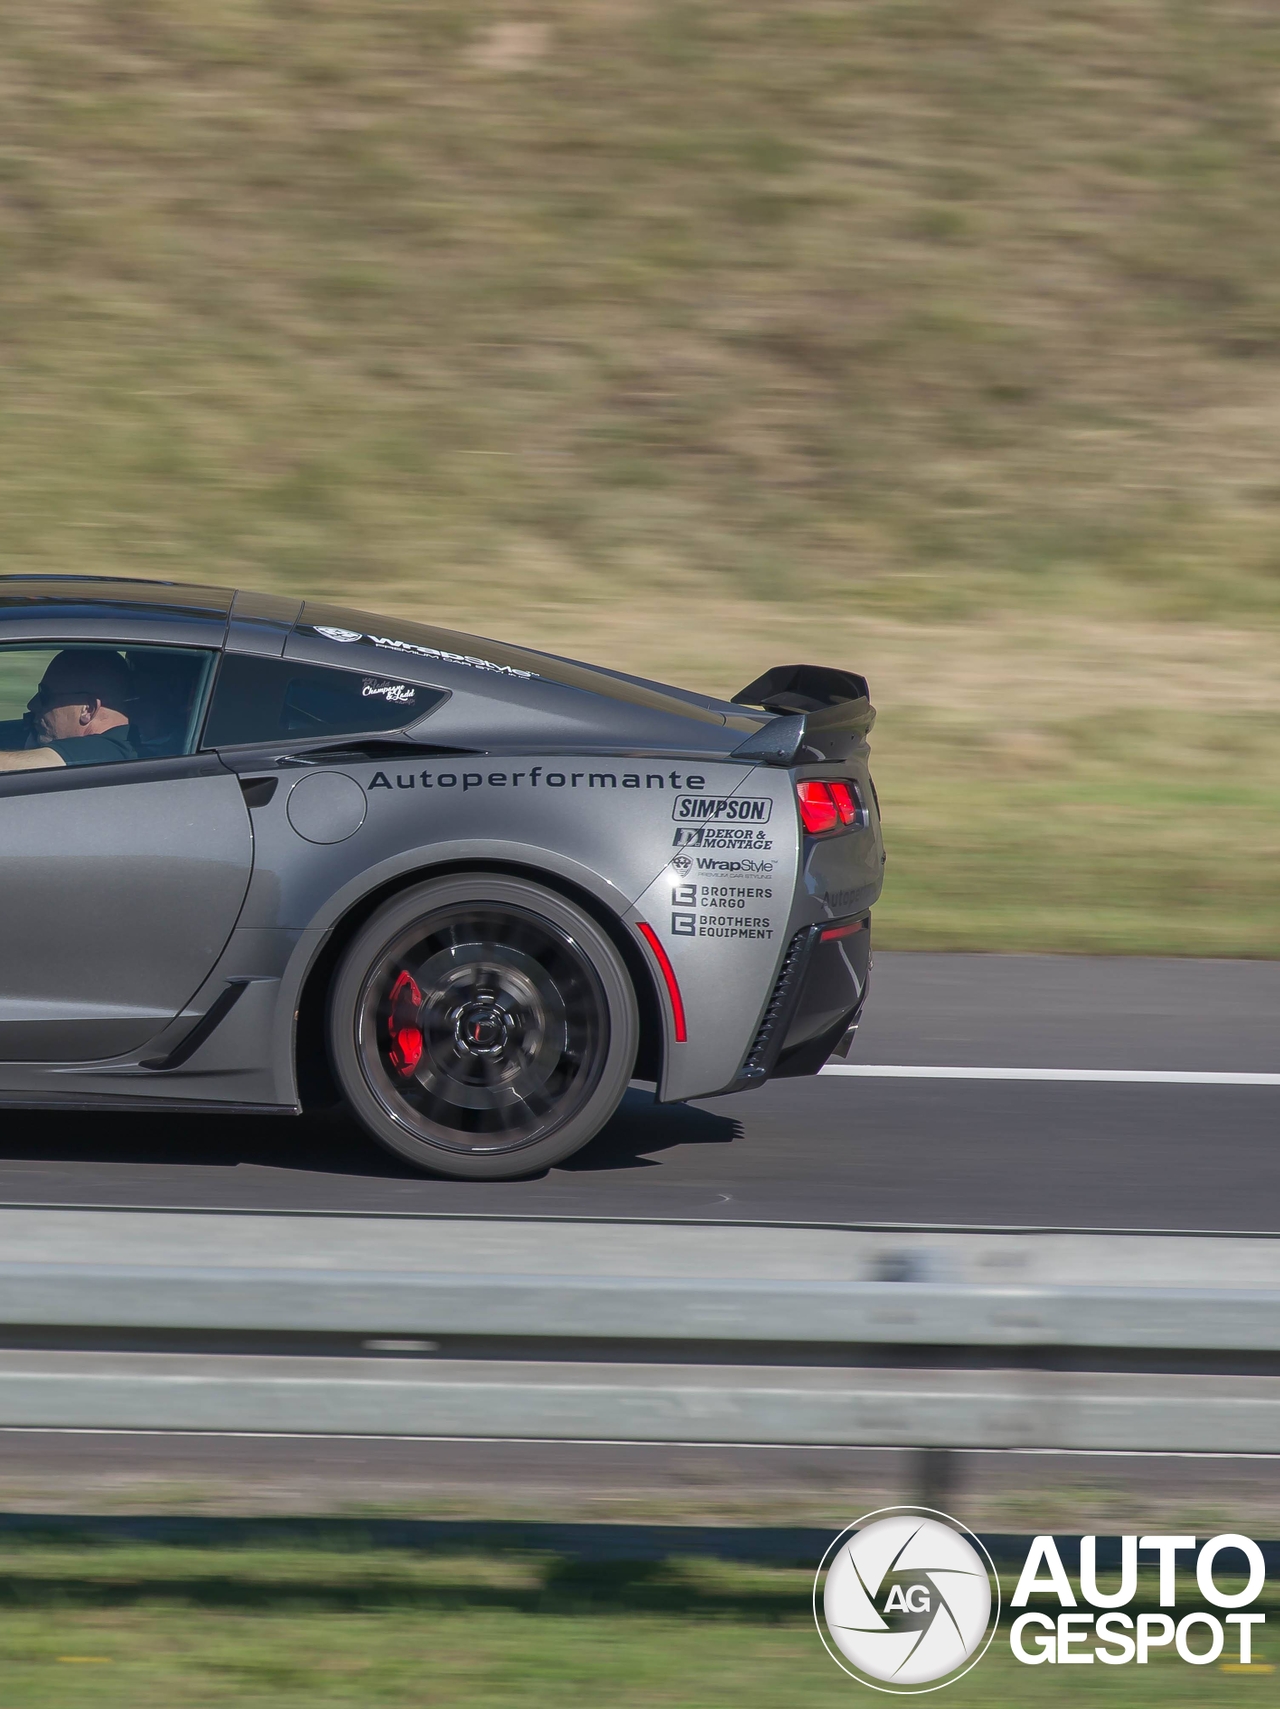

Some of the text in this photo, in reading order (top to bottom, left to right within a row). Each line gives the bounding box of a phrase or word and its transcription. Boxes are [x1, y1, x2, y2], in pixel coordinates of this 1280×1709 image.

[367, 766, 706, 792] Autoperformante
[680, 798, 765, 820] SIMPSON
[705, 828, 766, 840] DEKOR &
[702, 838, 773, 850] MONTAGE
[701, 886, 773, 898] BROTHERS
[701, 897, 746, 909] CARGO
[700, 915, 771, 928] BROTHERS
[699, 927, 774, 939] EQUIPMENT
